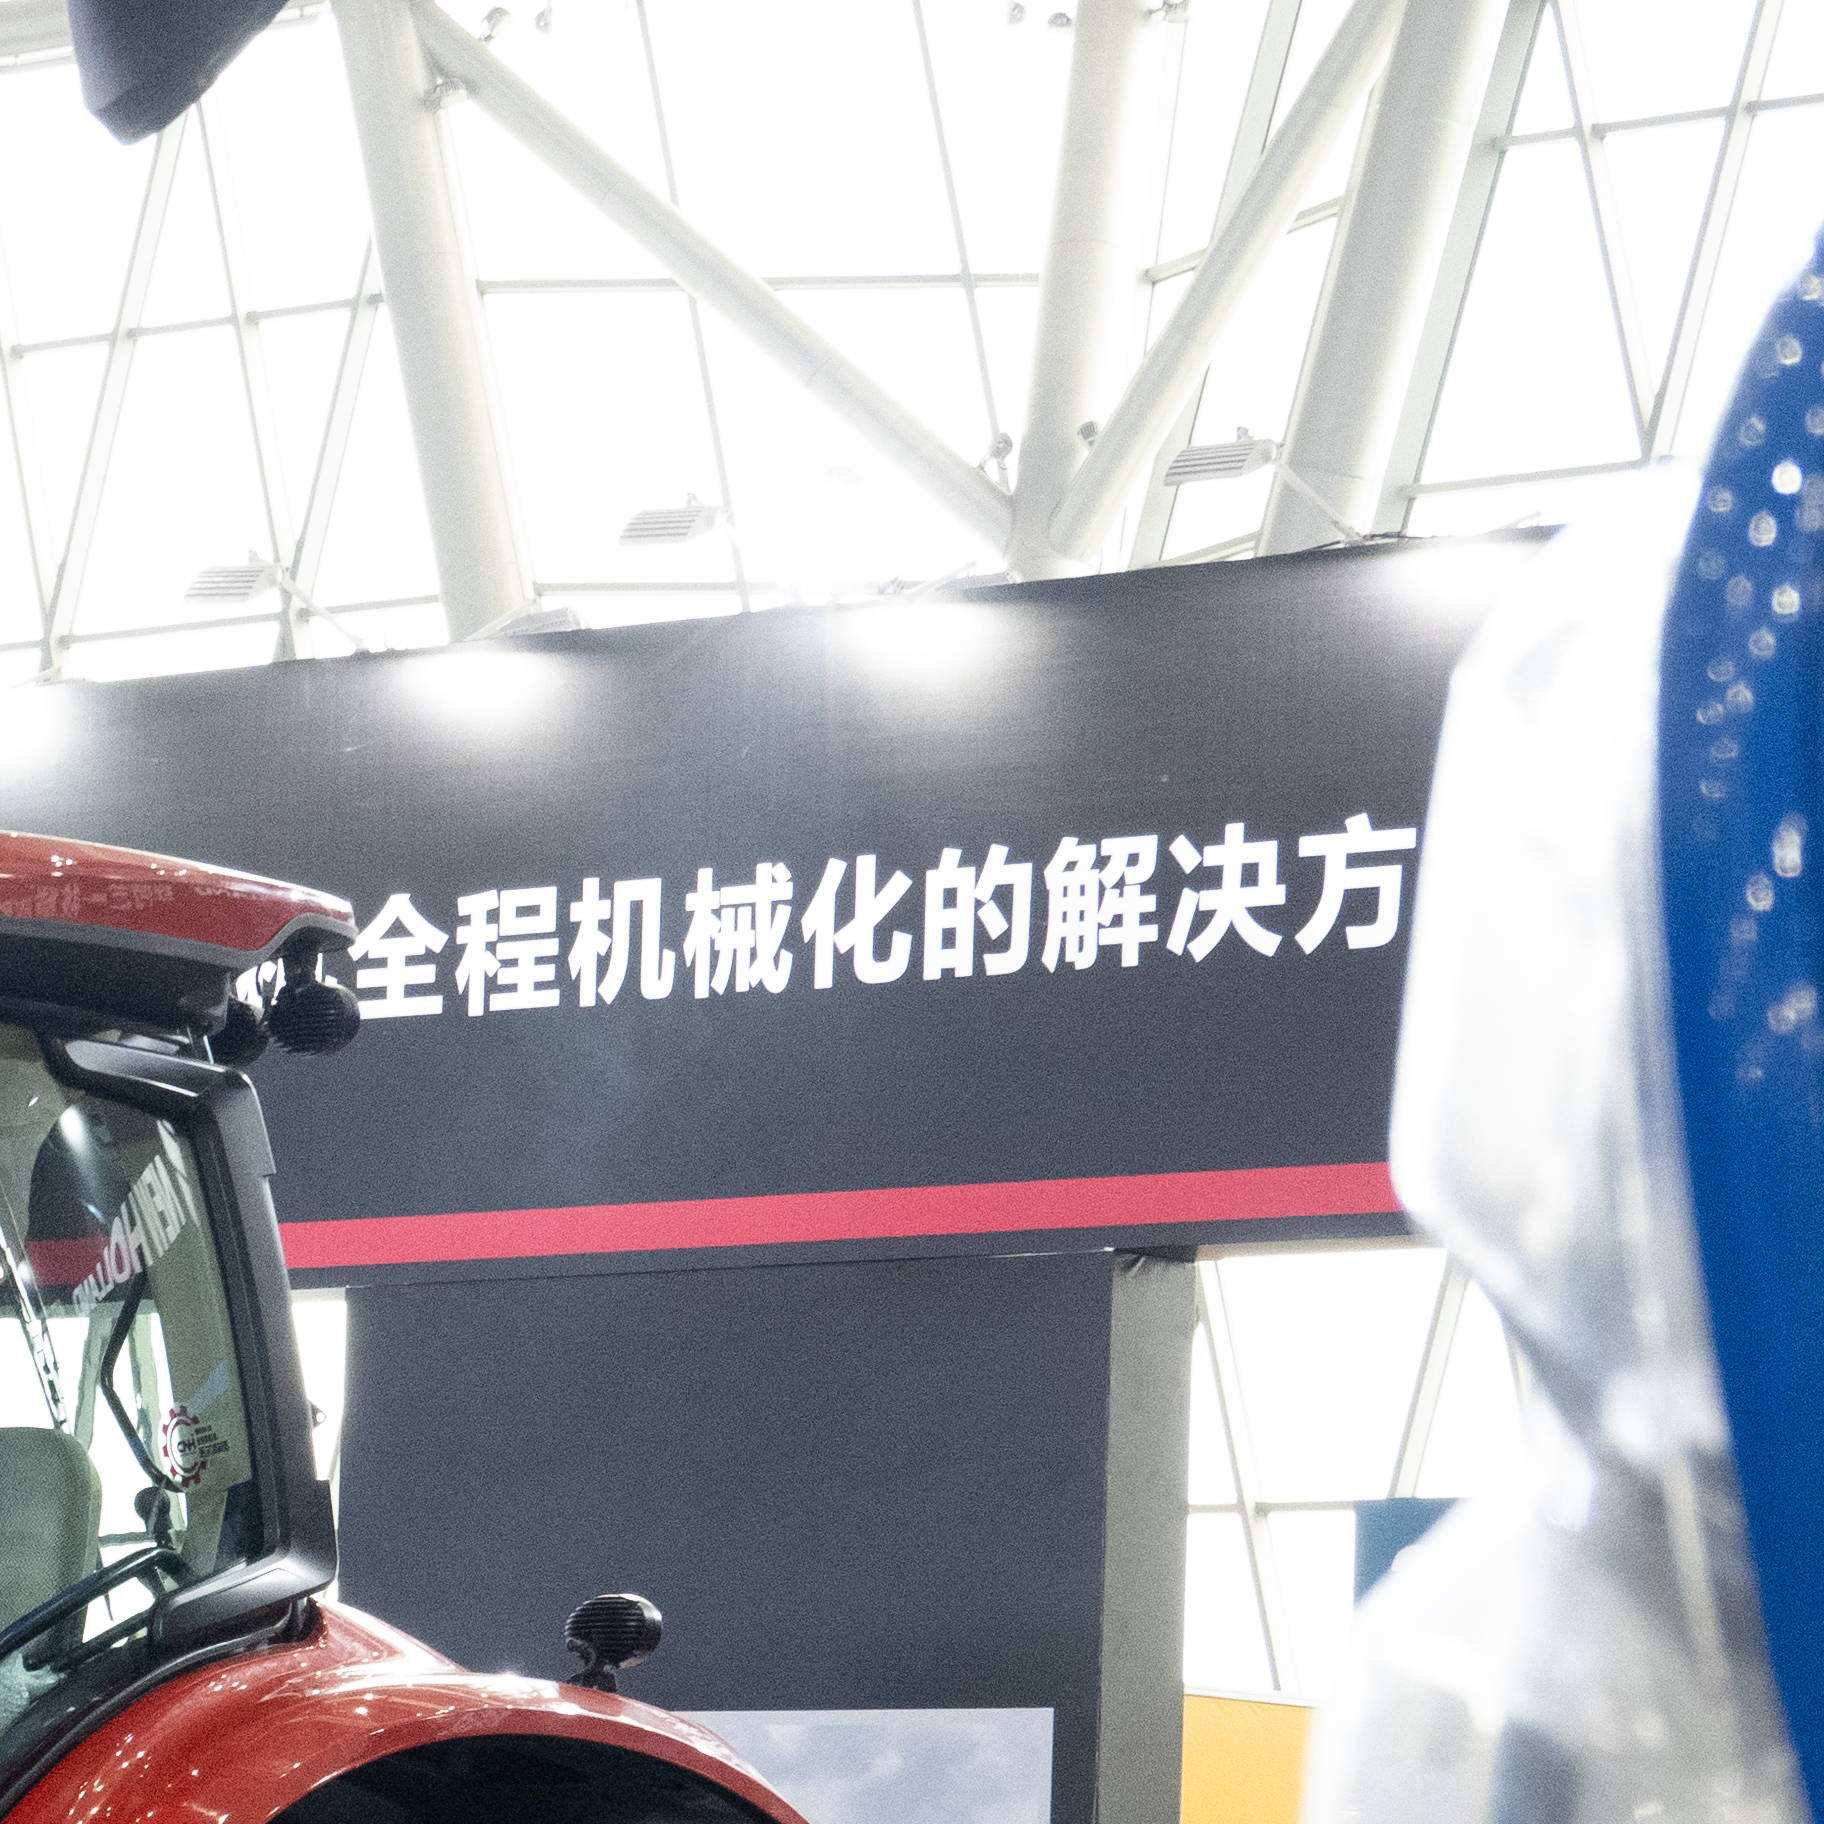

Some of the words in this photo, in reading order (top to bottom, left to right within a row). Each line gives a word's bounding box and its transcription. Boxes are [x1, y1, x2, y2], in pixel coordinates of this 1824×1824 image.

[235, 811, 1418, 1025] 全程机械化的解决方
